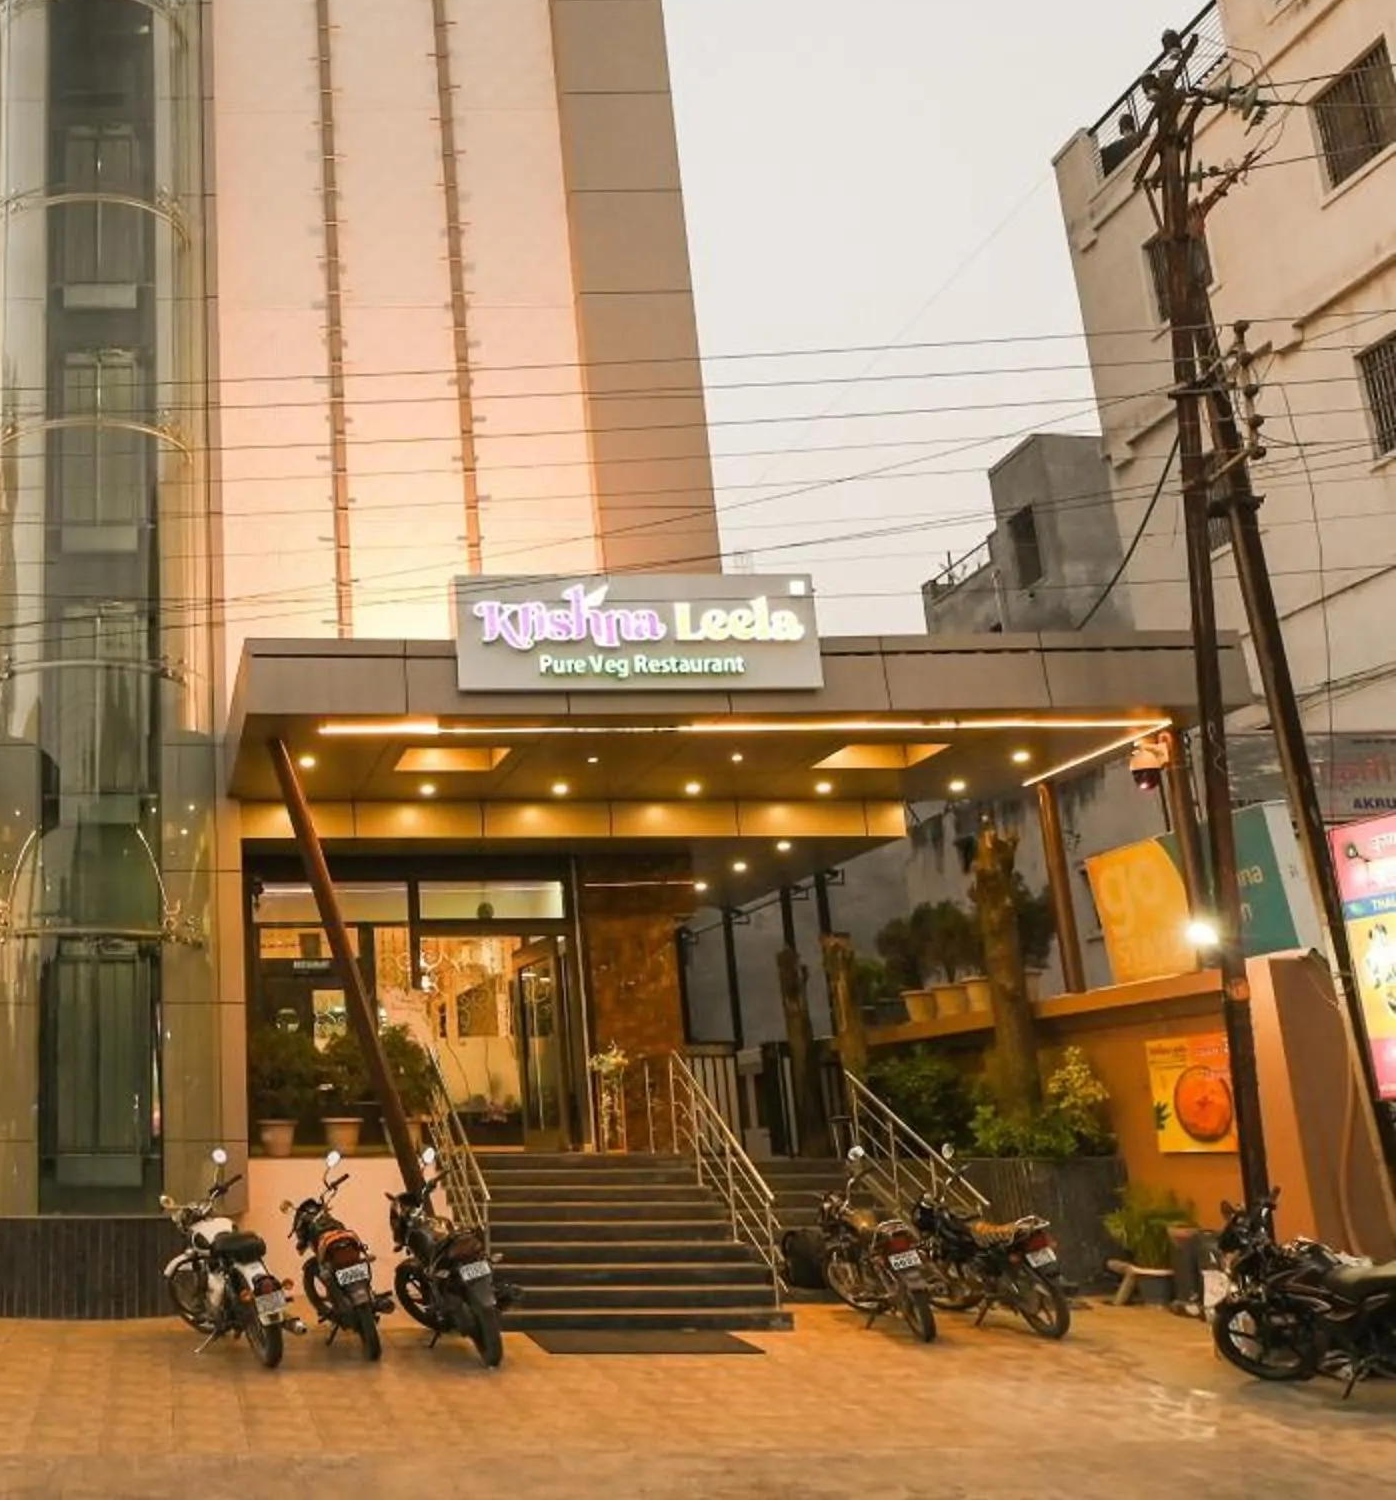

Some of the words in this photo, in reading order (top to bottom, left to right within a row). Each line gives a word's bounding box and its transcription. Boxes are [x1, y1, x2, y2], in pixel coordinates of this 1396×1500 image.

[473, 583, 666, 650] Krishna
[673, 596, 805, 643] Leela
[539, 654, 587, 674] Pure
[589, 654, 630, 679] Veg
[633, 654, 746, 675] Restaurant
